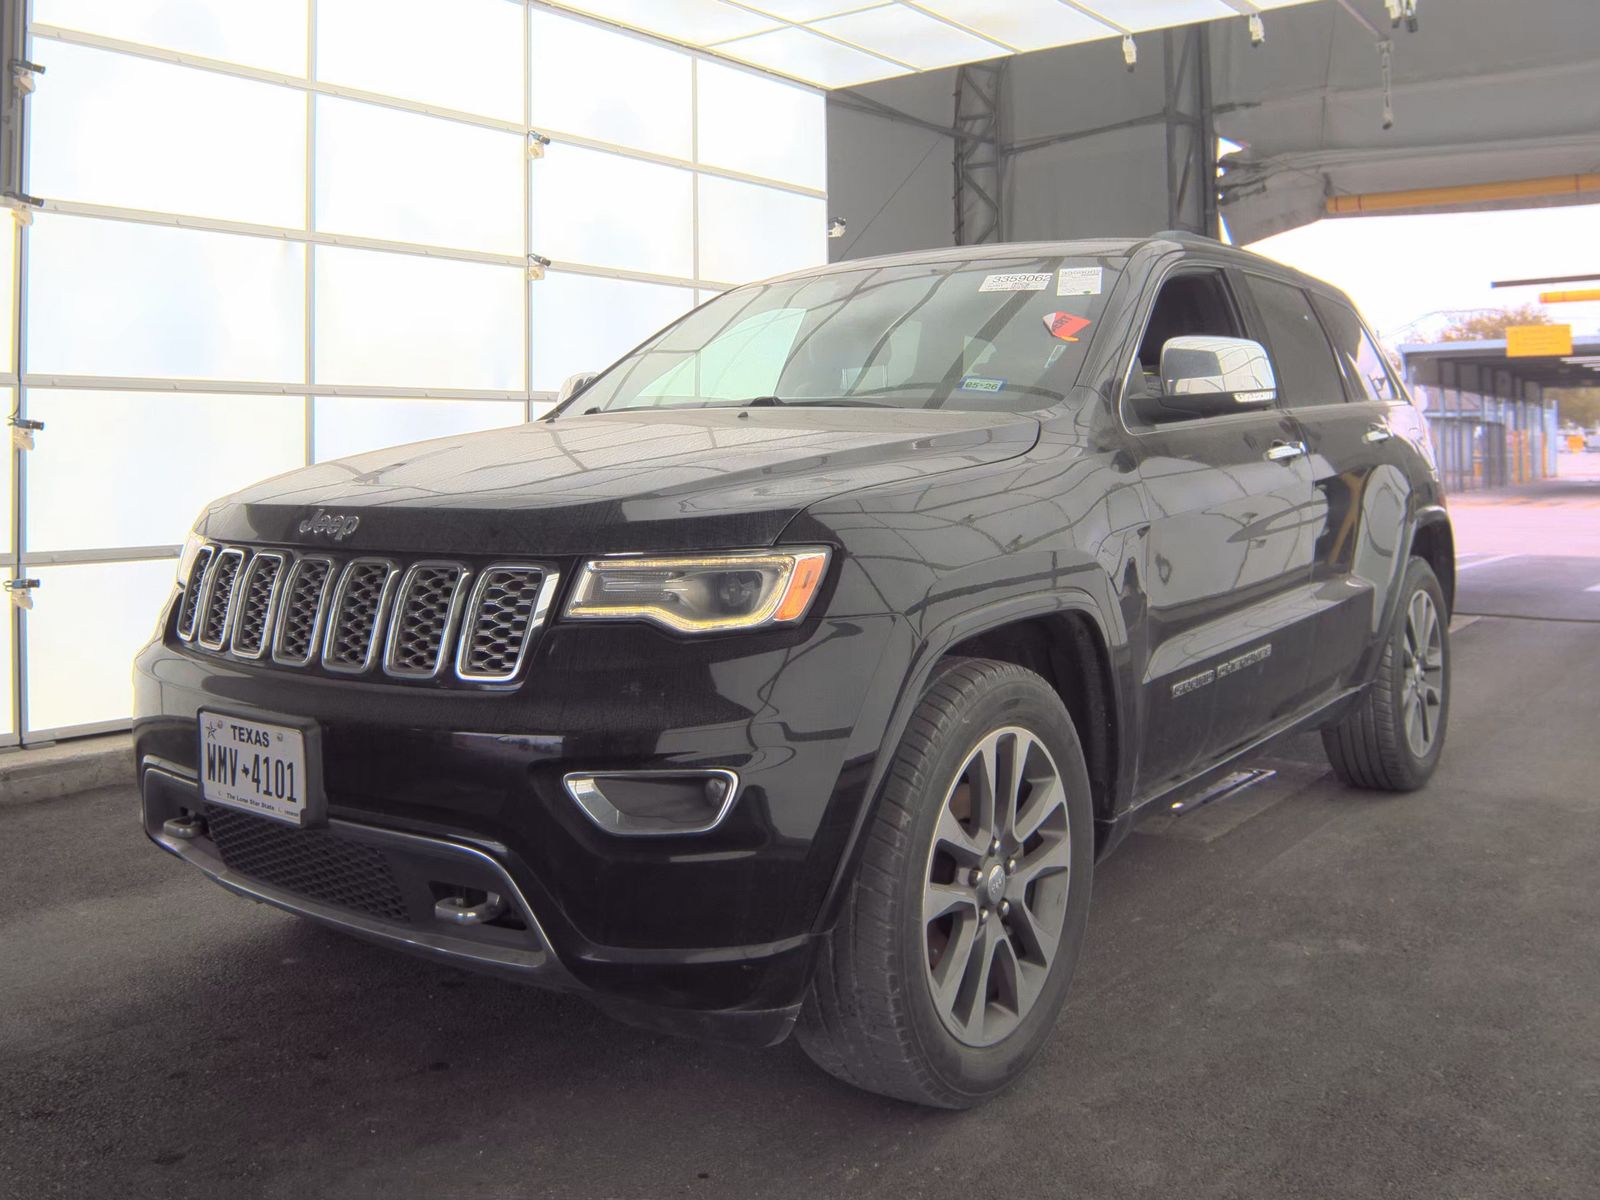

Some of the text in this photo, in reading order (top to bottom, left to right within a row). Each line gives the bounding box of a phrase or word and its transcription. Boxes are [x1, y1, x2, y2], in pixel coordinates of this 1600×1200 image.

[992, 274, 1052, 283] 3359062
[299, 509, 360, 540] Jeep
[230, 725, 270, 748] TEXAS
[207, 742, 297, 803] WMV 4101
[226, 792, 275, 811] The Lone Star State
